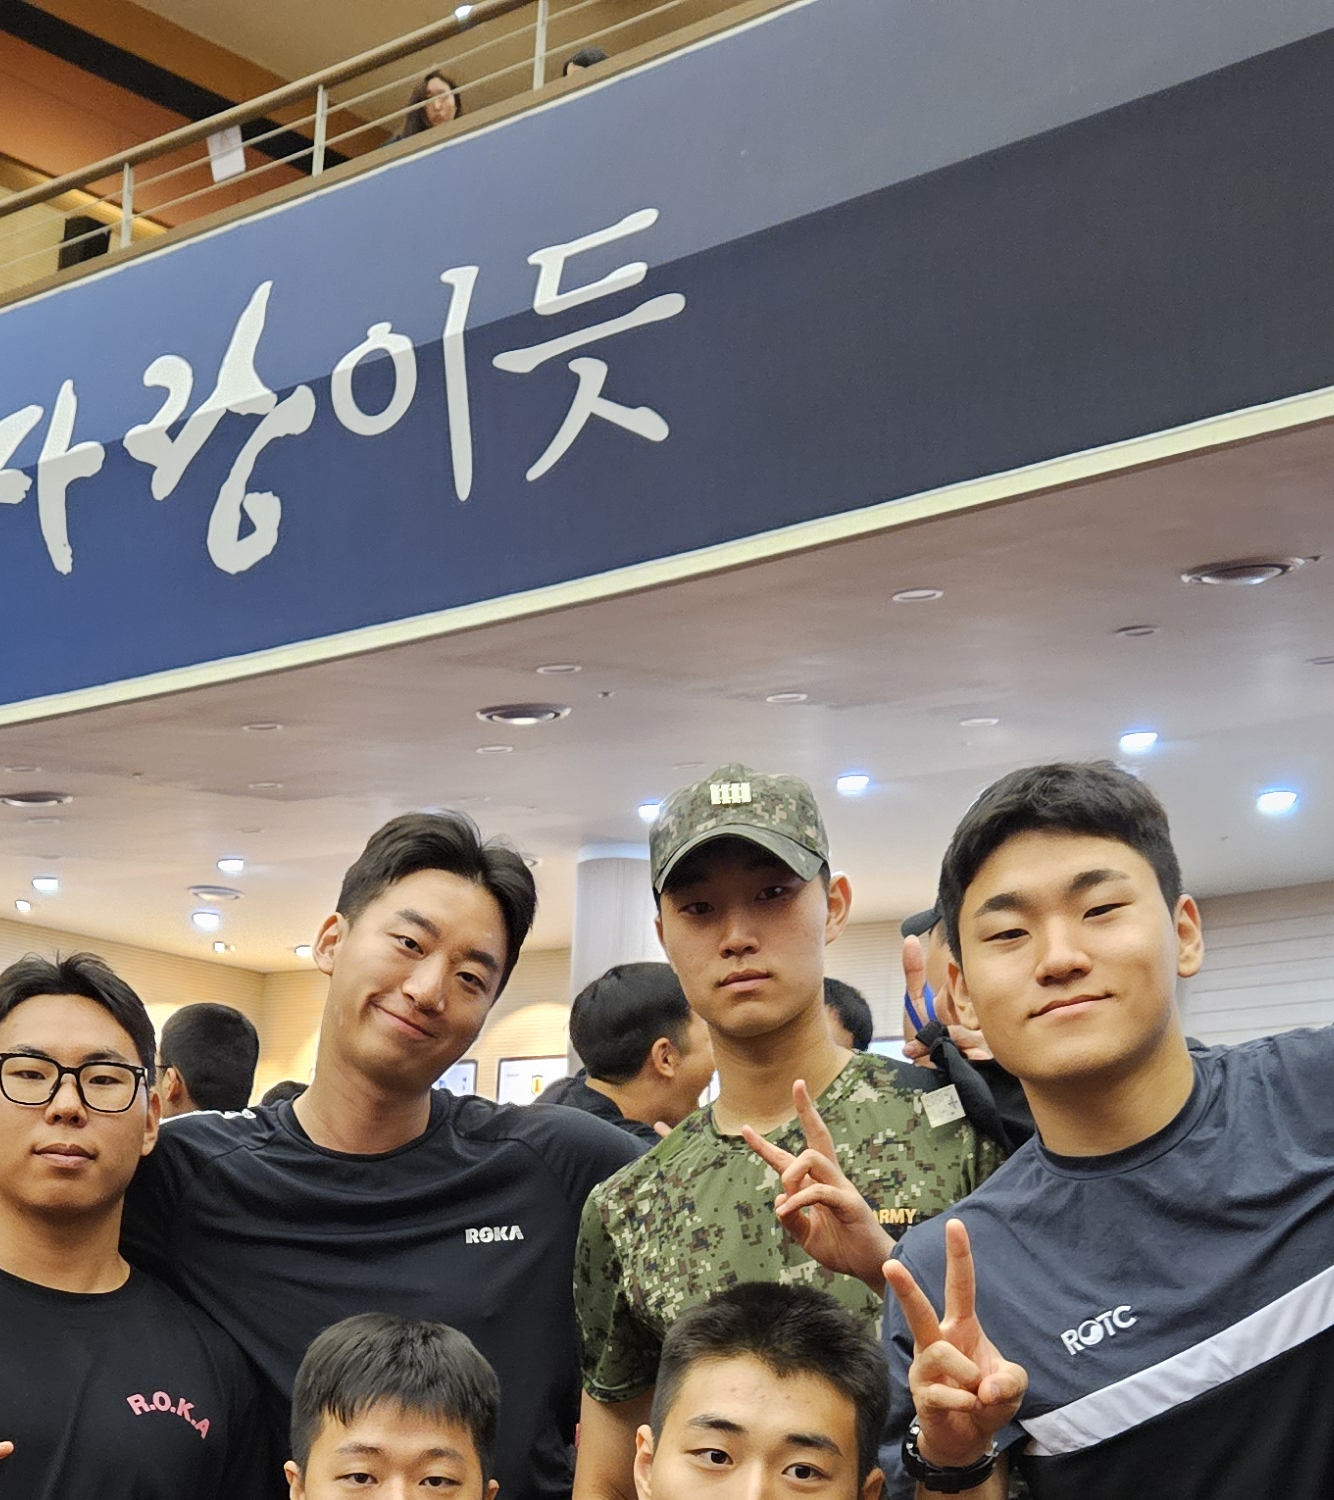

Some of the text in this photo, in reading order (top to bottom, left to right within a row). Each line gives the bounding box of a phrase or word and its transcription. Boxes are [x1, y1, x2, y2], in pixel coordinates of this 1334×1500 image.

[465, 1225, 525, 1244] ROKA
[1060, 1305, 1138, 1356] ROTC
[126, 1390, 211, 1440] R.O.K.A
